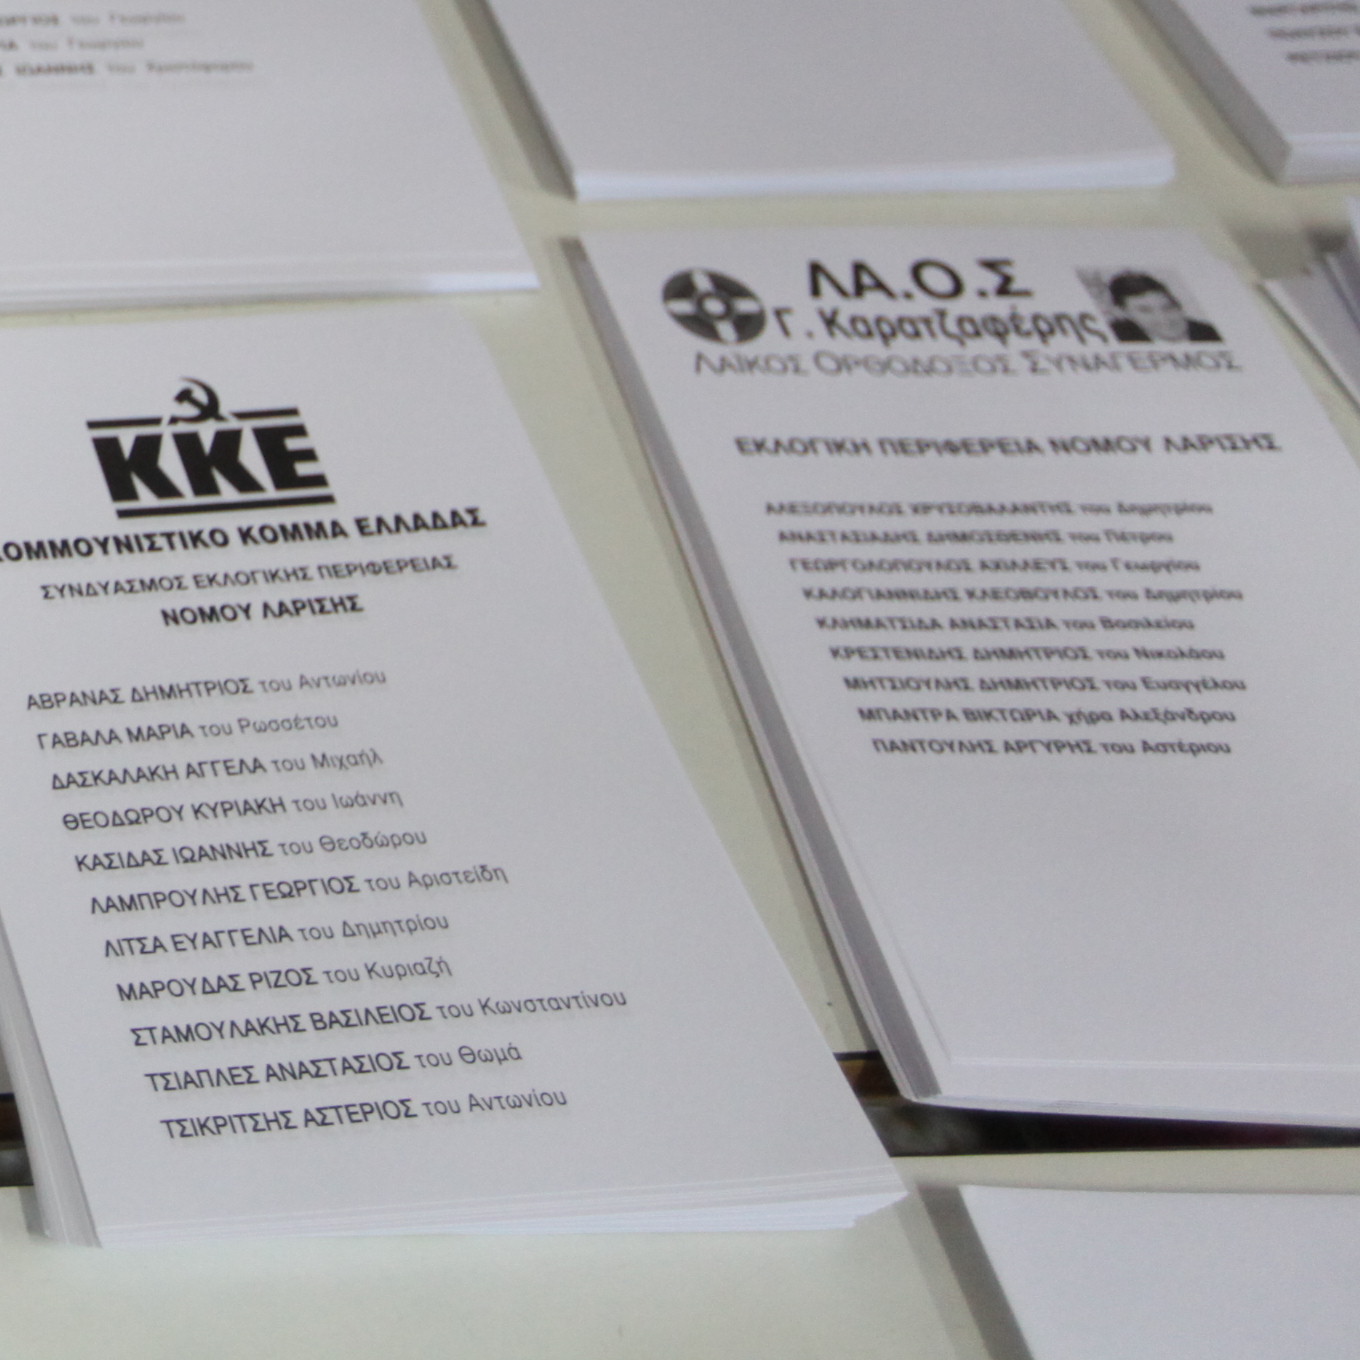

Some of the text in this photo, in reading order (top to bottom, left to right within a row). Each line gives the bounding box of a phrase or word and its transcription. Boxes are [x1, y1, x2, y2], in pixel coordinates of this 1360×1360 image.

[92, 423, 330, 503] ΚΚΕ
[238, 520, 348, 545] ΚΟΜΜΑ
[355, 508, 486, 537] ΕΛΛΑΔΑΣ
[41, 555, 457, 600] ΣΥΝΔΥΑΣΜΟΣ ΕΚΛΟΓΙΚΗΣ ΠΕΡΙΦΕΡΕΙΑΣ
[161, 595, 363, 626] ΝΟΜΟΥ ΛΑΡΙΣΗΣ
[52, 748, 383, 790] ΔΑΣΚΑΛΑΚΗ ΑΓΓΕΛΑ του Μιχαήλ
[75, 832, 427, 872] ΚΑΣΙΔΑΣ ΙΩΑΝΝΗΣ του Θεοδώρου
[91, 864, 508, 914] ΛΑΜΠΡΟΥΛΗΣ ΓΕΩΡΓΙΟΣ του Αριστείδη
[105, 914, 449, 957] ΛΙΤΣΑ ΕΥΑΓΓΕΛΙΑ του Δημητρίου
[117, 956, 452, 1001] ΜΑΡΟΥΔΑΣ ΡΙΖΟΣ του Κυριαζή
[130, 991, 627, 1046] ΣΤΑΜΟΥΛΑΚΗΣ ΒΑΣΙΛΕΙΟΣ του Κωνσταντίνου
[144, 1043, 522, 1091] ΤΣΙΑΠΛΕΣ ΑΝΑΣΤΑΣΙΟΣ του Θωμά
[160, 1092, 567, 1138] ΤΣΙΚΡΙΤΣΗΣ ΑΣΤΕΡΙΟΣ του Αντωνίου
